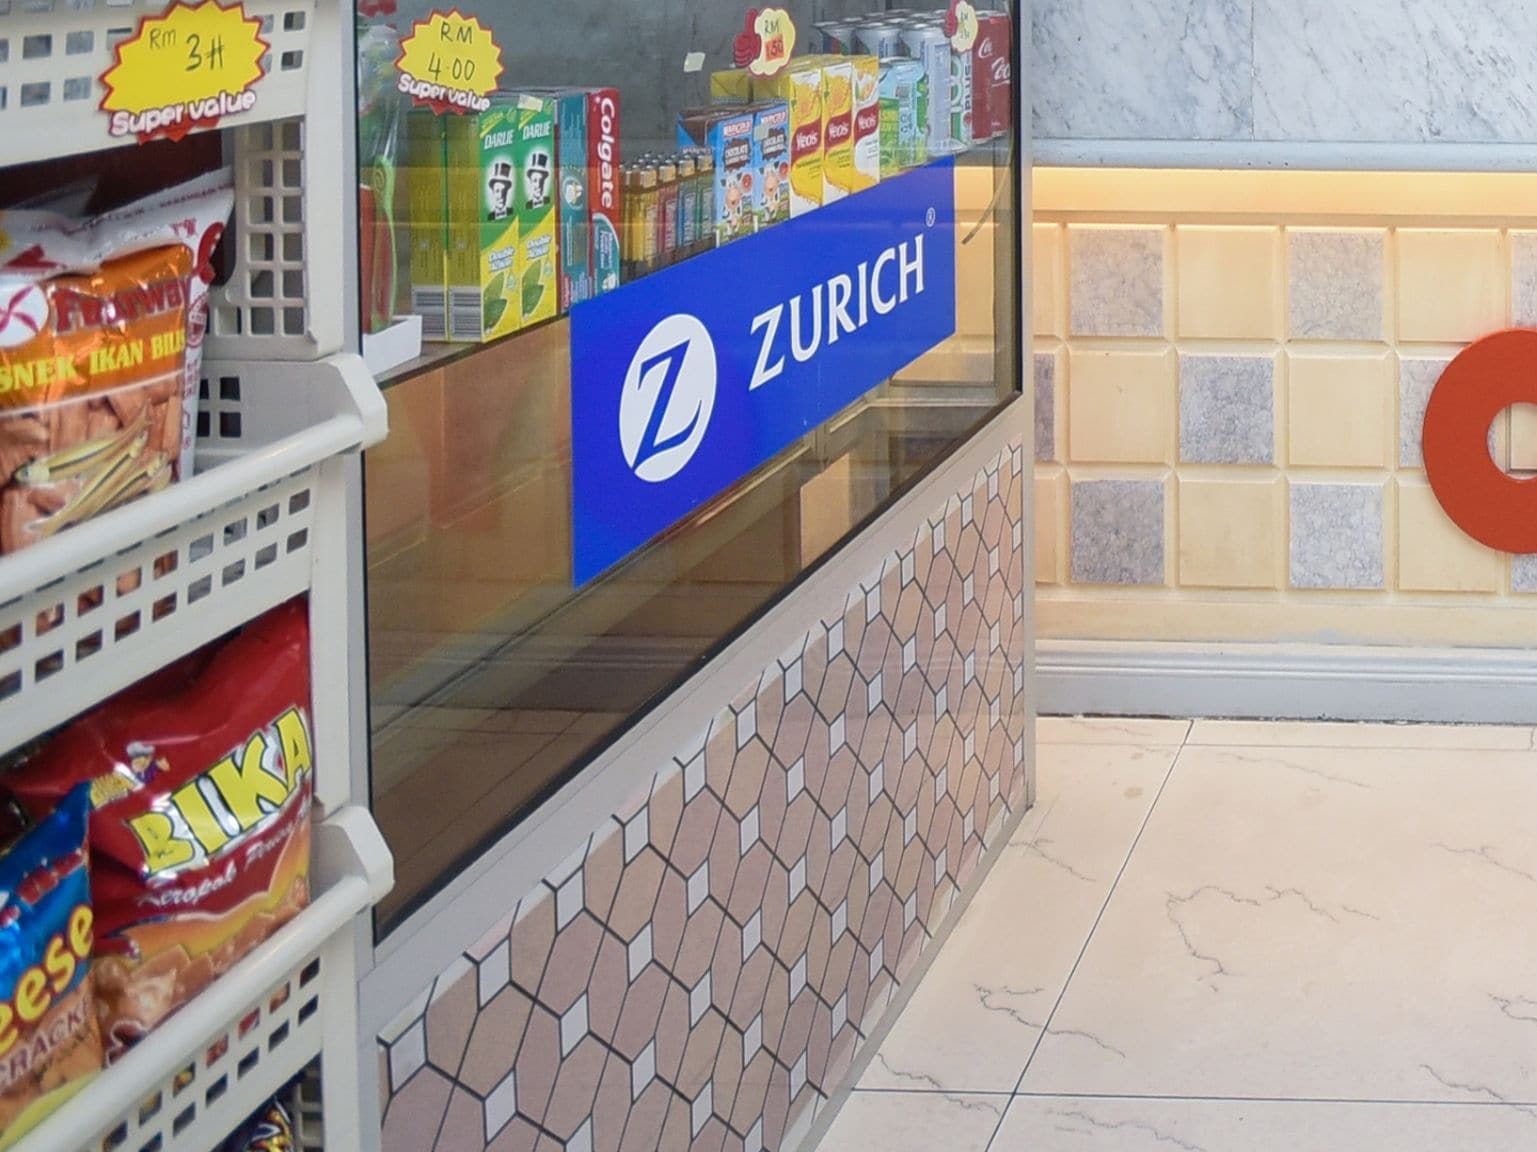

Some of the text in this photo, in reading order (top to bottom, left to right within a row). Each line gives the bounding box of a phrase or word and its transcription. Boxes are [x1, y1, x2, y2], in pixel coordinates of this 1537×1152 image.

[440, 21, 473, 44] RM
[109, 89, 257, 136] Super value
[397, 73, 491, 112] Super value
[484, 129, 515, 150] DARLIE
[523, 121, 551, 141] DARLIE
[597, 96, 616, 210] Colgate
[749, 234, 925, 391] ZURICH
[0, 355, 78, 393] SNEK
[89, 339, 144, 375] IKAN
[127, 706, 313, 878] BIKA
